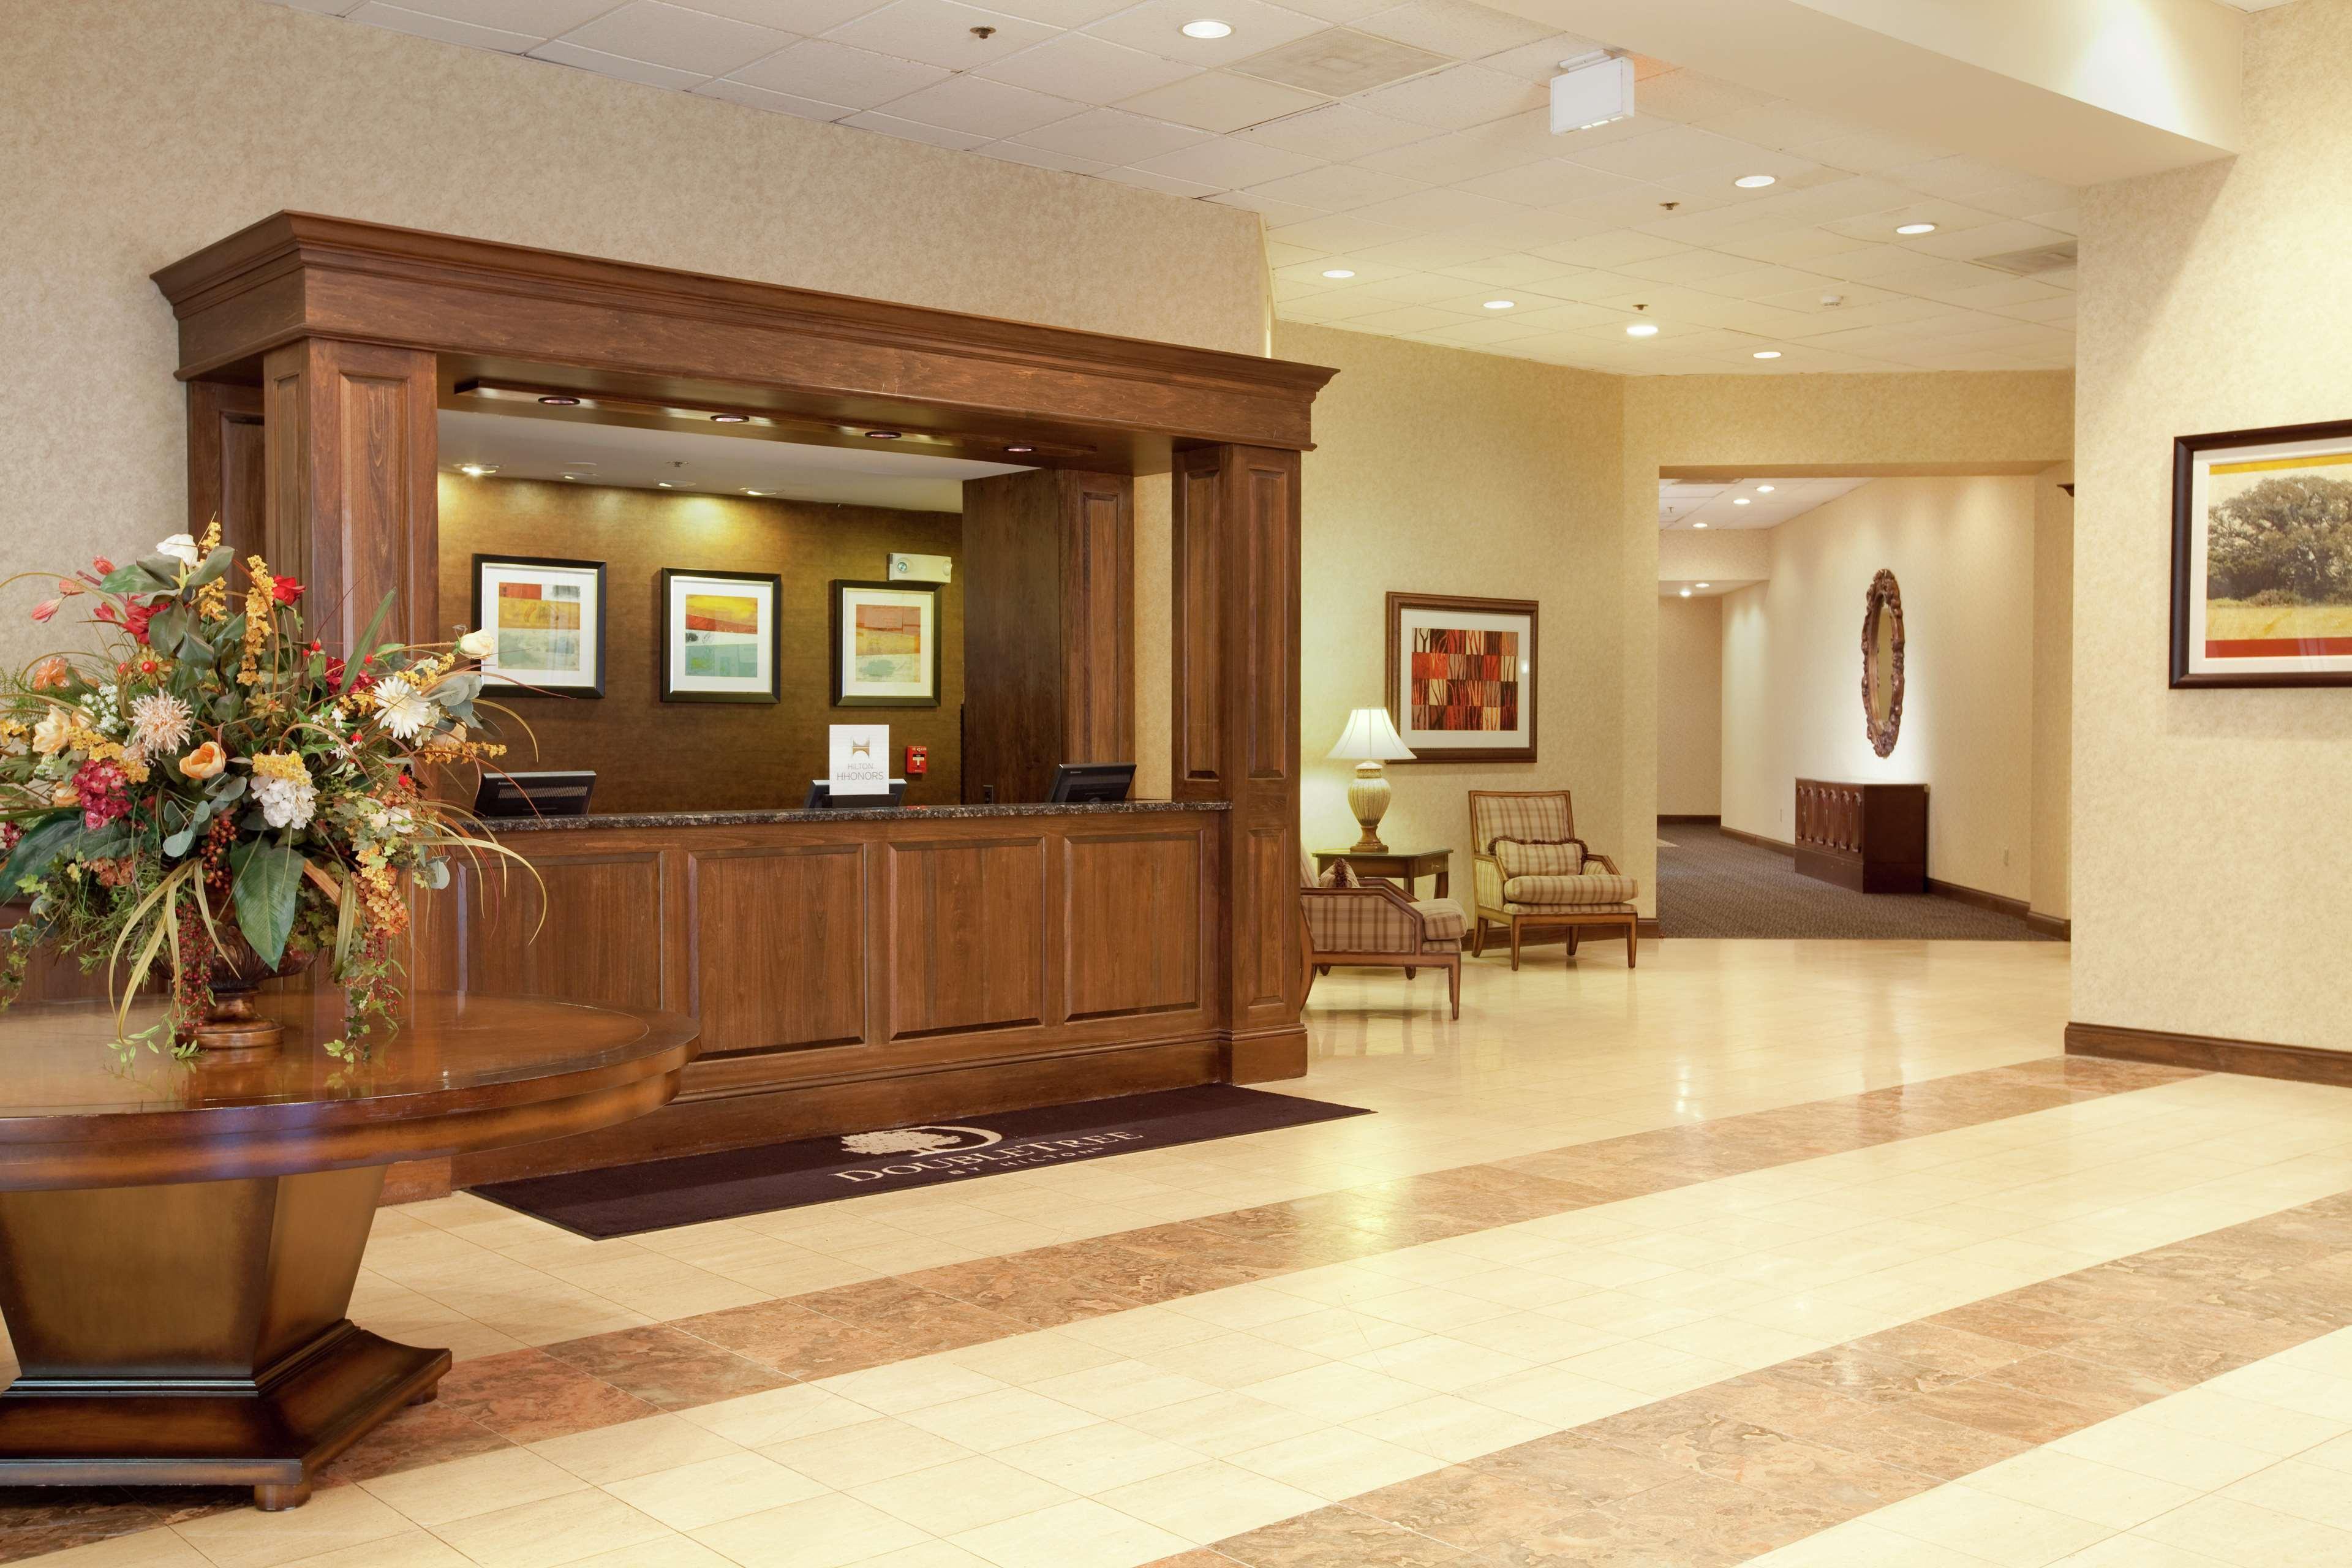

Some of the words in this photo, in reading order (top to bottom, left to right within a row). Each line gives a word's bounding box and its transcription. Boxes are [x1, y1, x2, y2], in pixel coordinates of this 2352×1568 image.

[837, 772, 884, 780] HHONORS
[827, 1131, 1144, 1183] DOUBLETREE
[947, 1167, 981, 1175] BY
[999, 1150, 1095, 1166] HILTON
